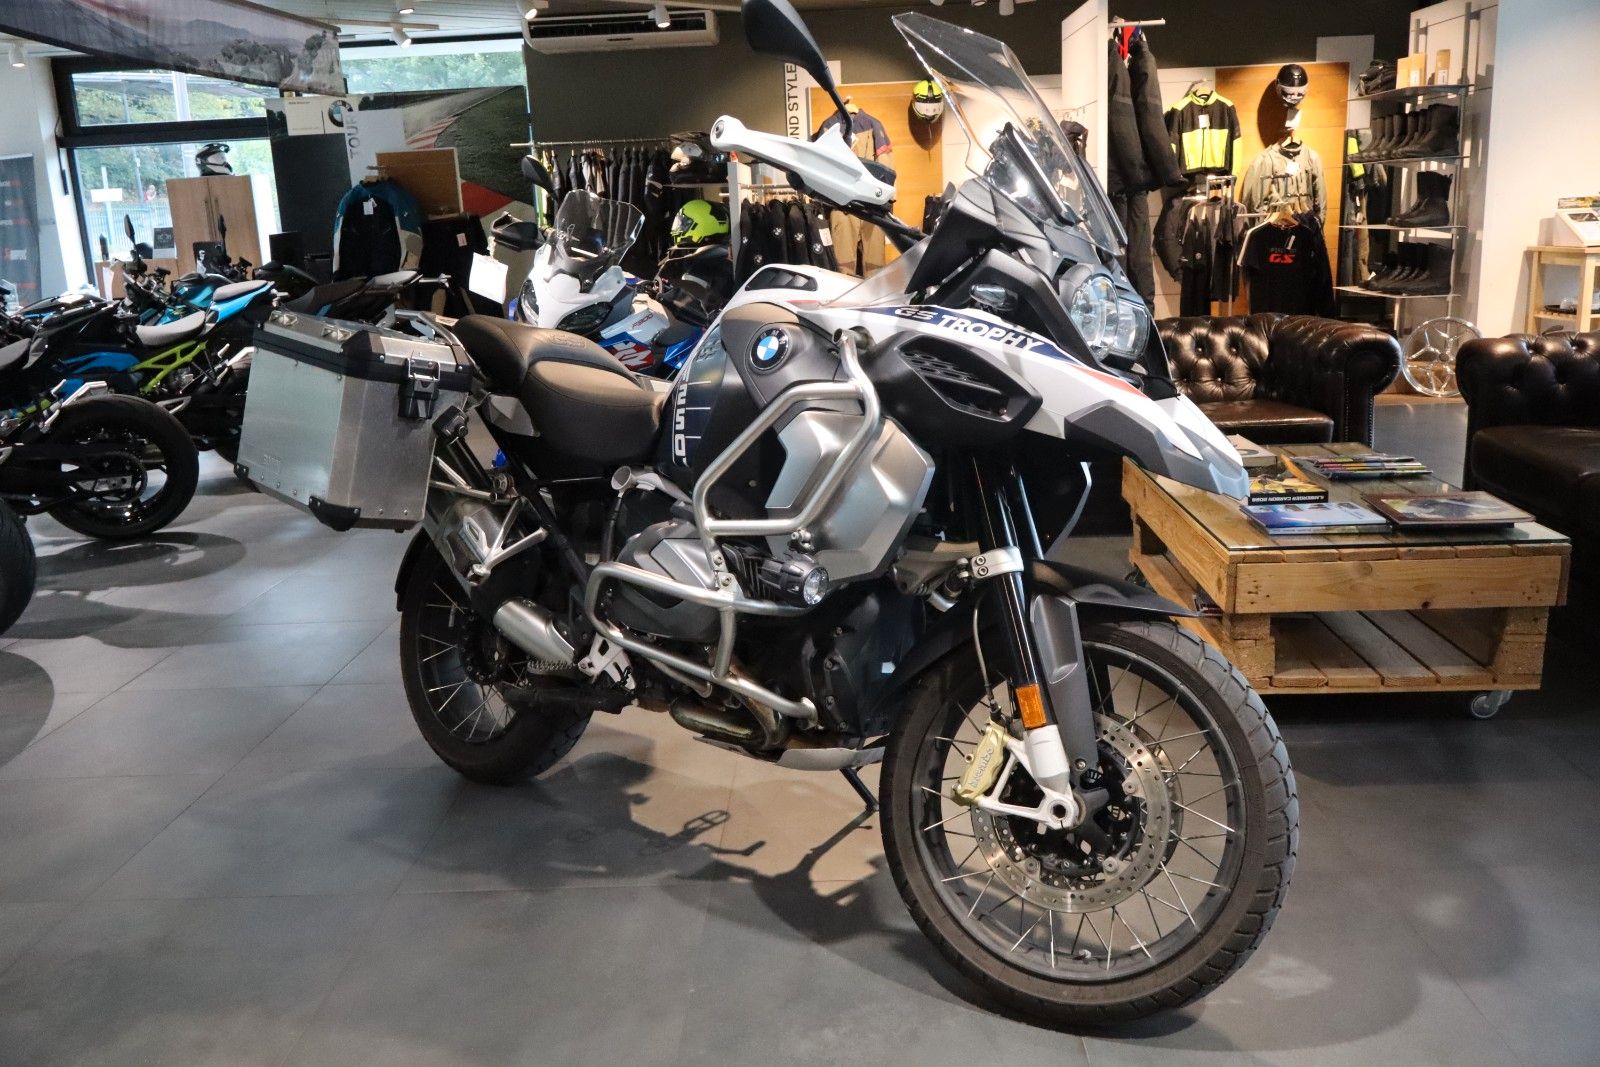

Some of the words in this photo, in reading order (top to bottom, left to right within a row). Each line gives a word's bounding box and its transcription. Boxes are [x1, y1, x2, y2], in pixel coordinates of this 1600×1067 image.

[786, 64, 799, 112] STYLE
[788, 115, 800, 140] ND
[1269, 253, 1296, 264] GS
[894, 306, 939, 321] GS
[937, 314, 1044, 352] TROPHY
[968, 746, 995, 789] brembo
